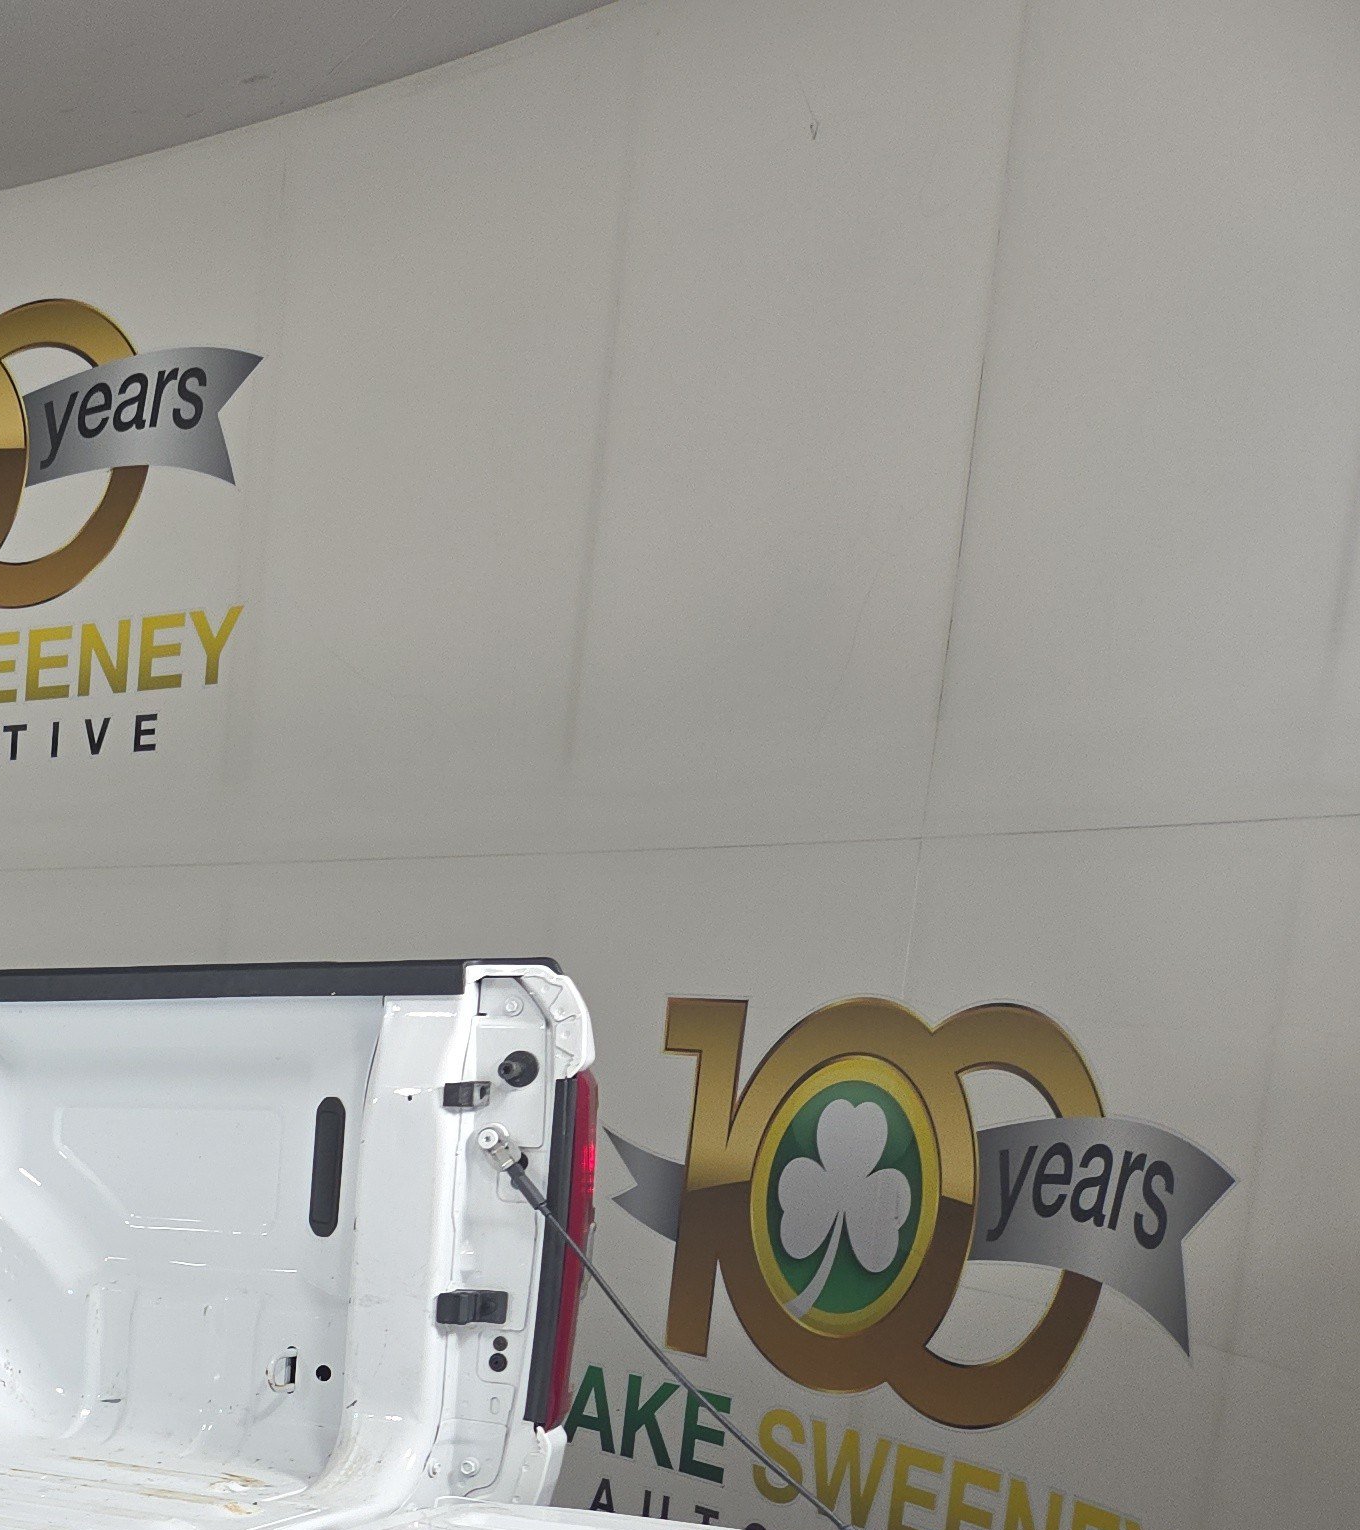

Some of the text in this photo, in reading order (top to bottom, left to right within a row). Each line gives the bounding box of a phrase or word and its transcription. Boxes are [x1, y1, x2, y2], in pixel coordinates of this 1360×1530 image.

[38, 364, 208, 471] years
[664, 996, 1106, 1431] 100
[986, 1141, 1175, 1251] years
[562, 1364, 733, 1485] AKE
